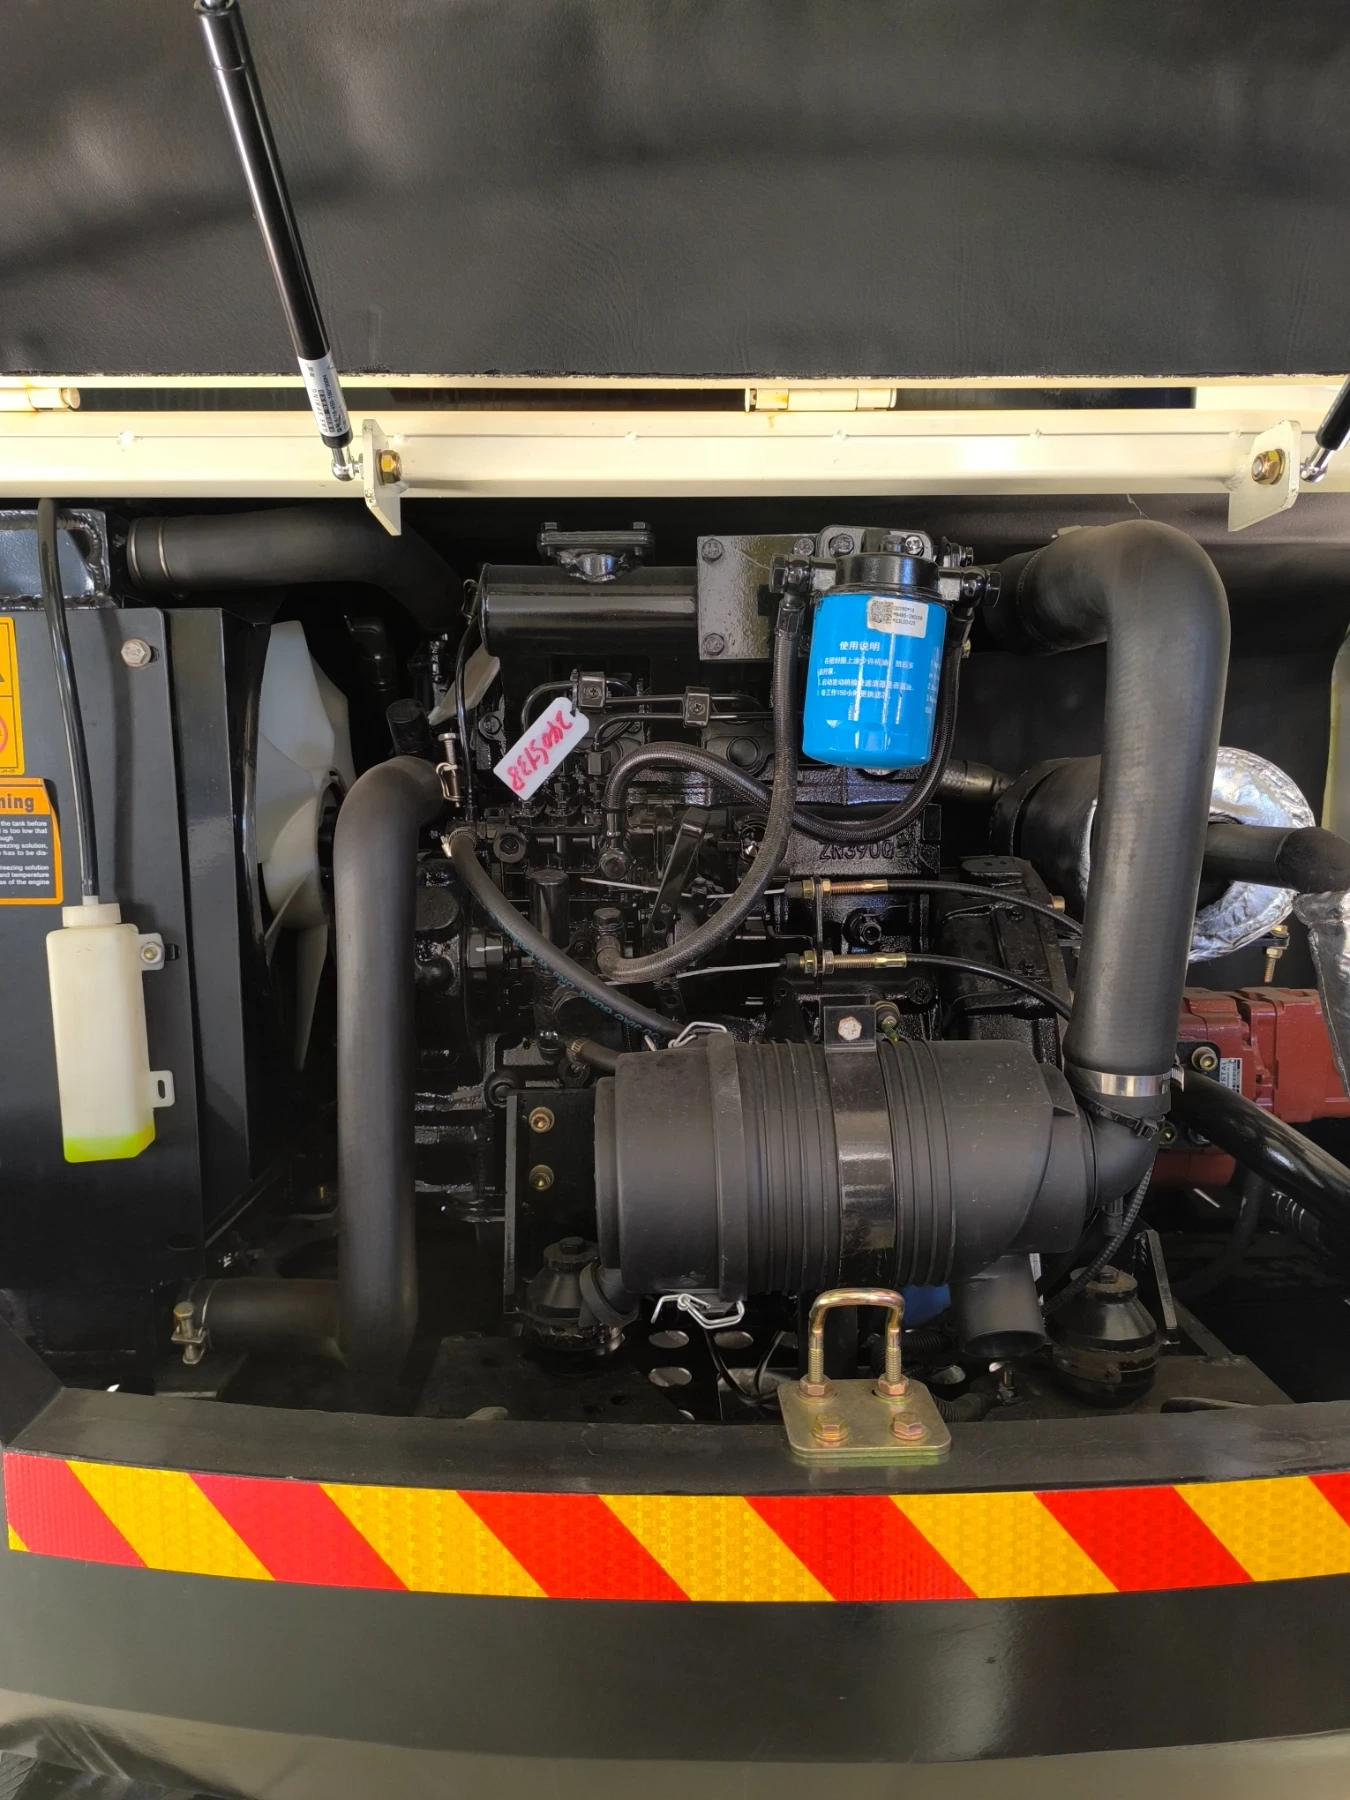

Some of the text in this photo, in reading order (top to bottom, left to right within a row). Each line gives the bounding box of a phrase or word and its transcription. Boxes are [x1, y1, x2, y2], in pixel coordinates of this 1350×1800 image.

[839, 641, 880, 651] 使用说明
[28, 879, 51, 887] engine
[579, 990, 613, 1014] GUAN
